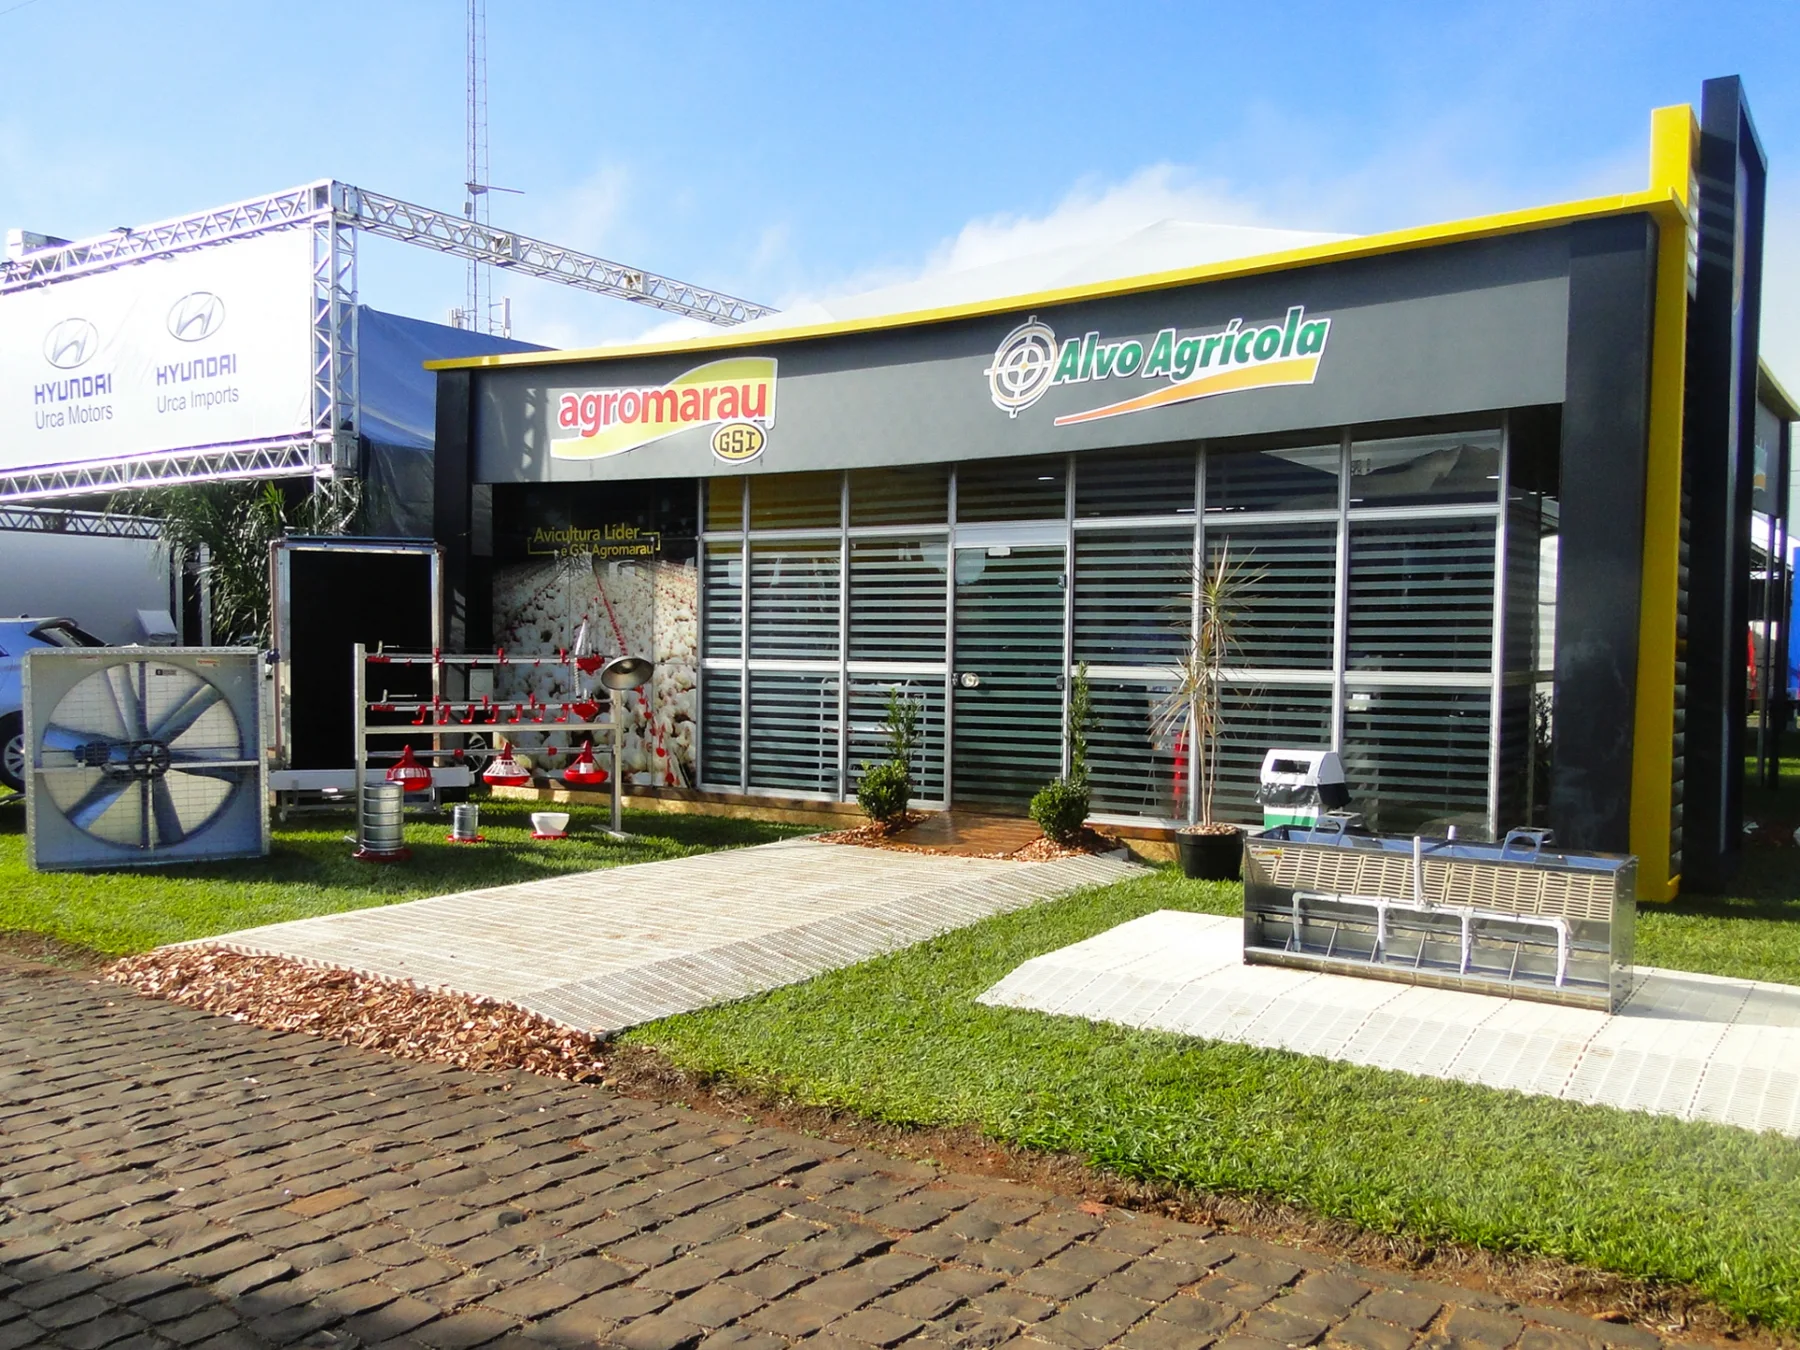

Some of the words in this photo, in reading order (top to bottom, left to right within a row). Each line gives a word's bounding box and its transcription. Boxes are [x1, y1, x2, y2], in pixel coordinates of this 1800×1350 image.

[1053, 333, 1142, 383] Alvo
[1145, 308, 1329, 382] Agrícola
[156, 353, 237, 386] HYUNDAI
[34, 373, 112, 405] HYUNDAI
[157, 394, 187, 413] Urca
[191, 386, 239, 409] Imports
[35, 409, 65, 429] Urca
[68, 405, 113, 425] Motors
[559, 384, 766, 437] agromarau
[719, 430, 755, 454] GSI
[533, 525, 600, 542] Avicultura
[604, 522, 640, 540] Líder
[592, 544, 653, 559] Agromarau
